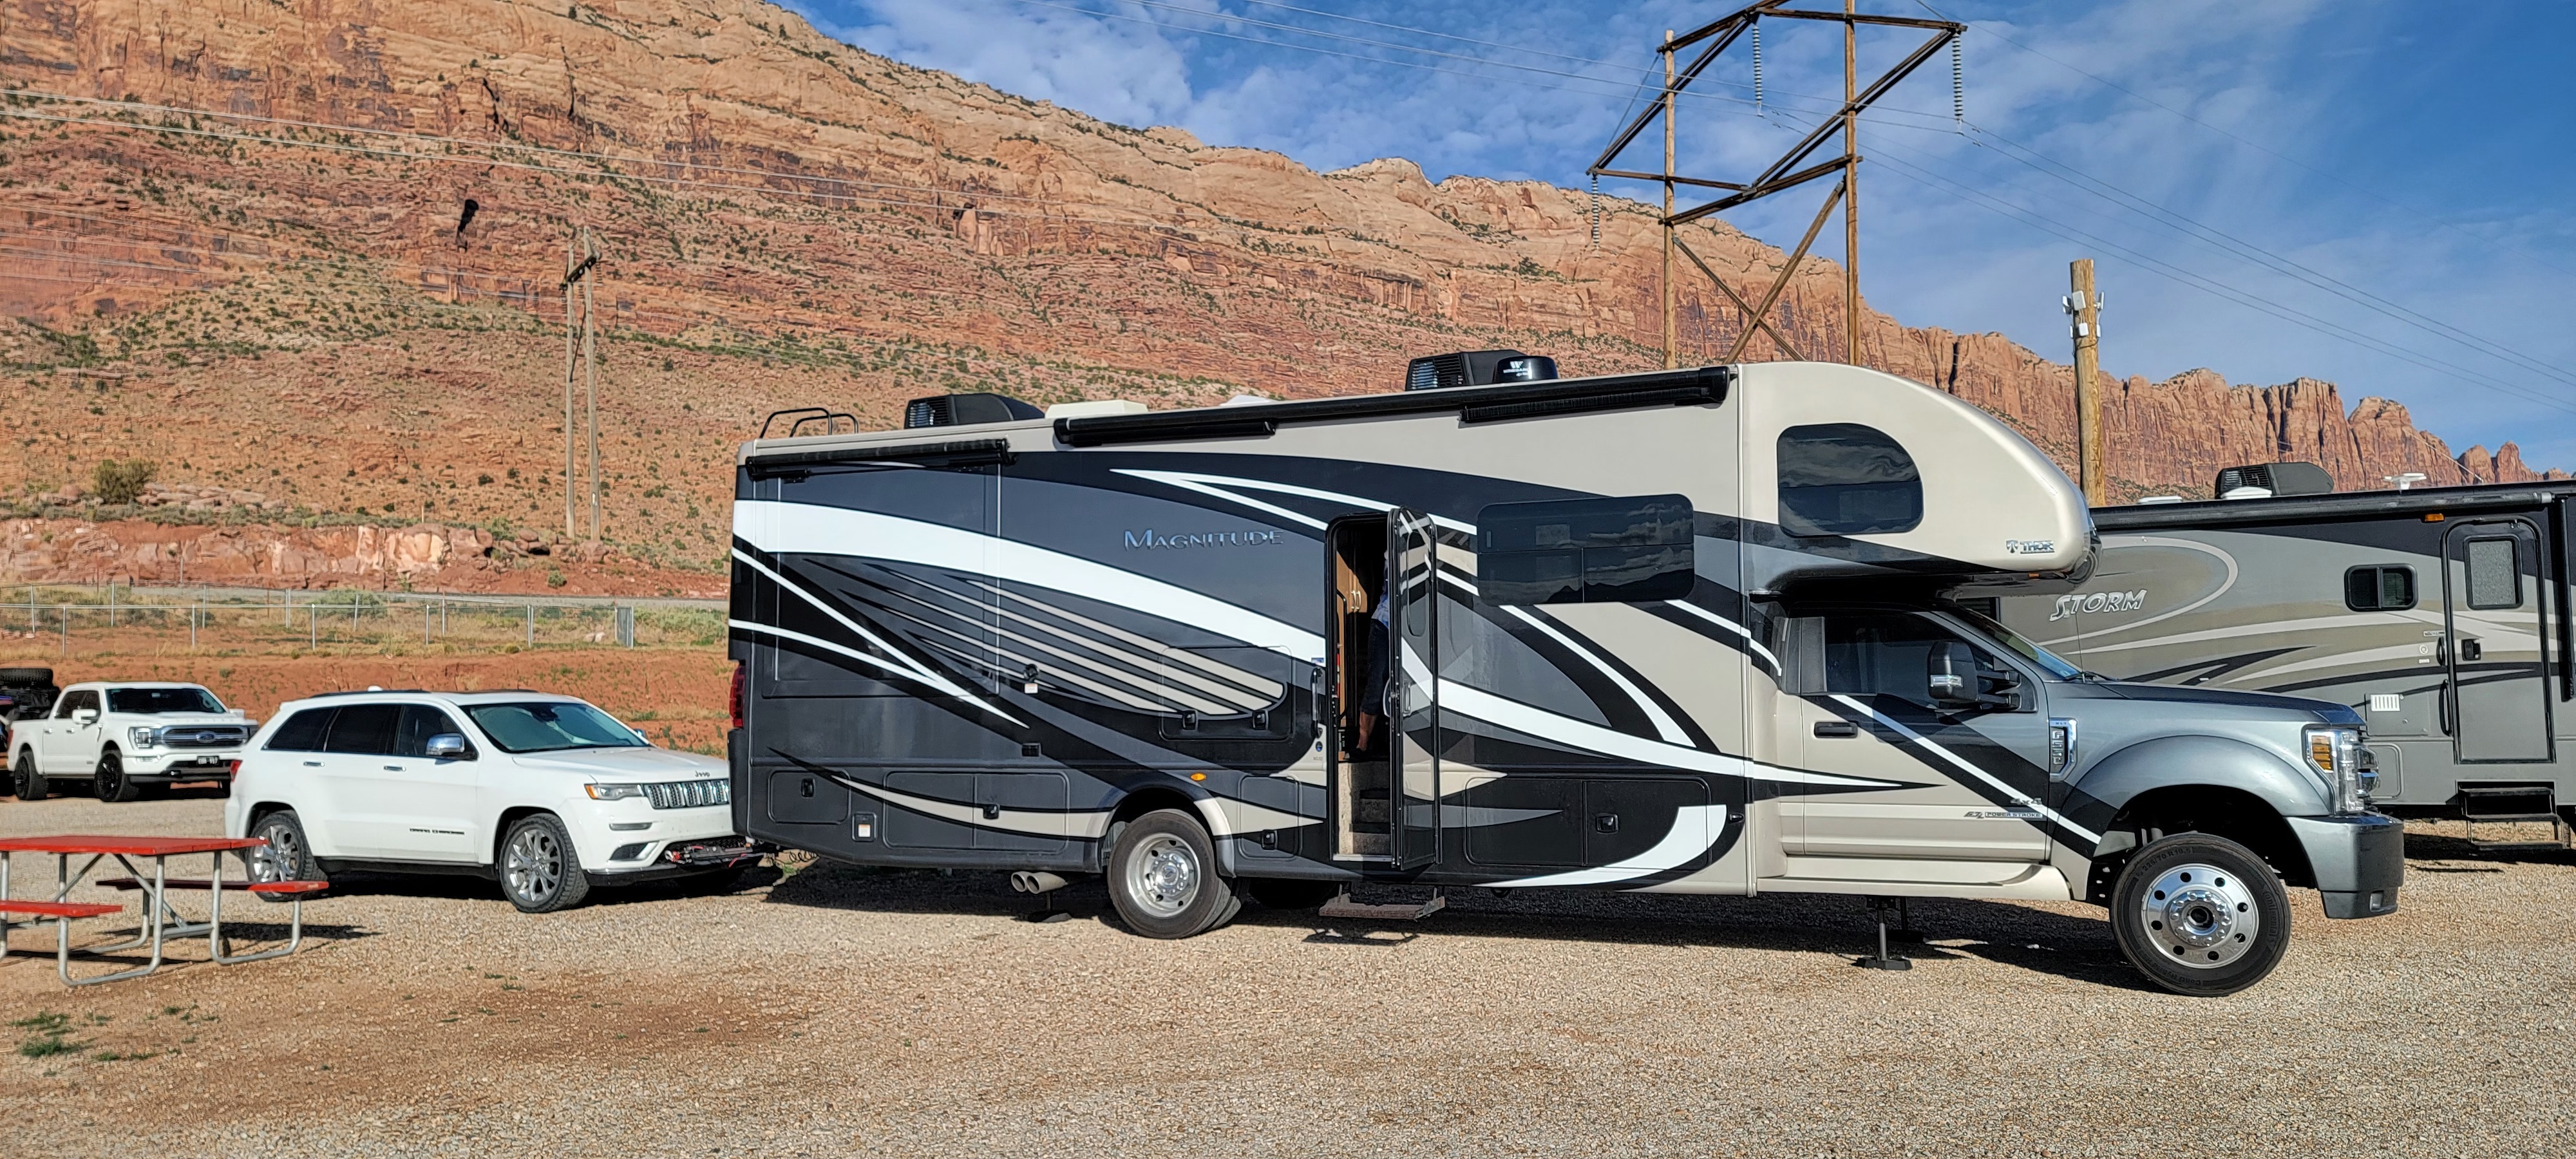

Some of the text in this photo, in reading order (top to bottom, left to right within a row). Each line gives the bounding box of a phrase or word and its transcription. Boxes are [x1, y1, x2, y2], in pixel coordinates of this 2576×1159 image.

[1124, 528, 1283, 551] MAGNITUDE
[2020, 540, 2054, 552] THOR
[2049, 589, 2148, 622] STORM
